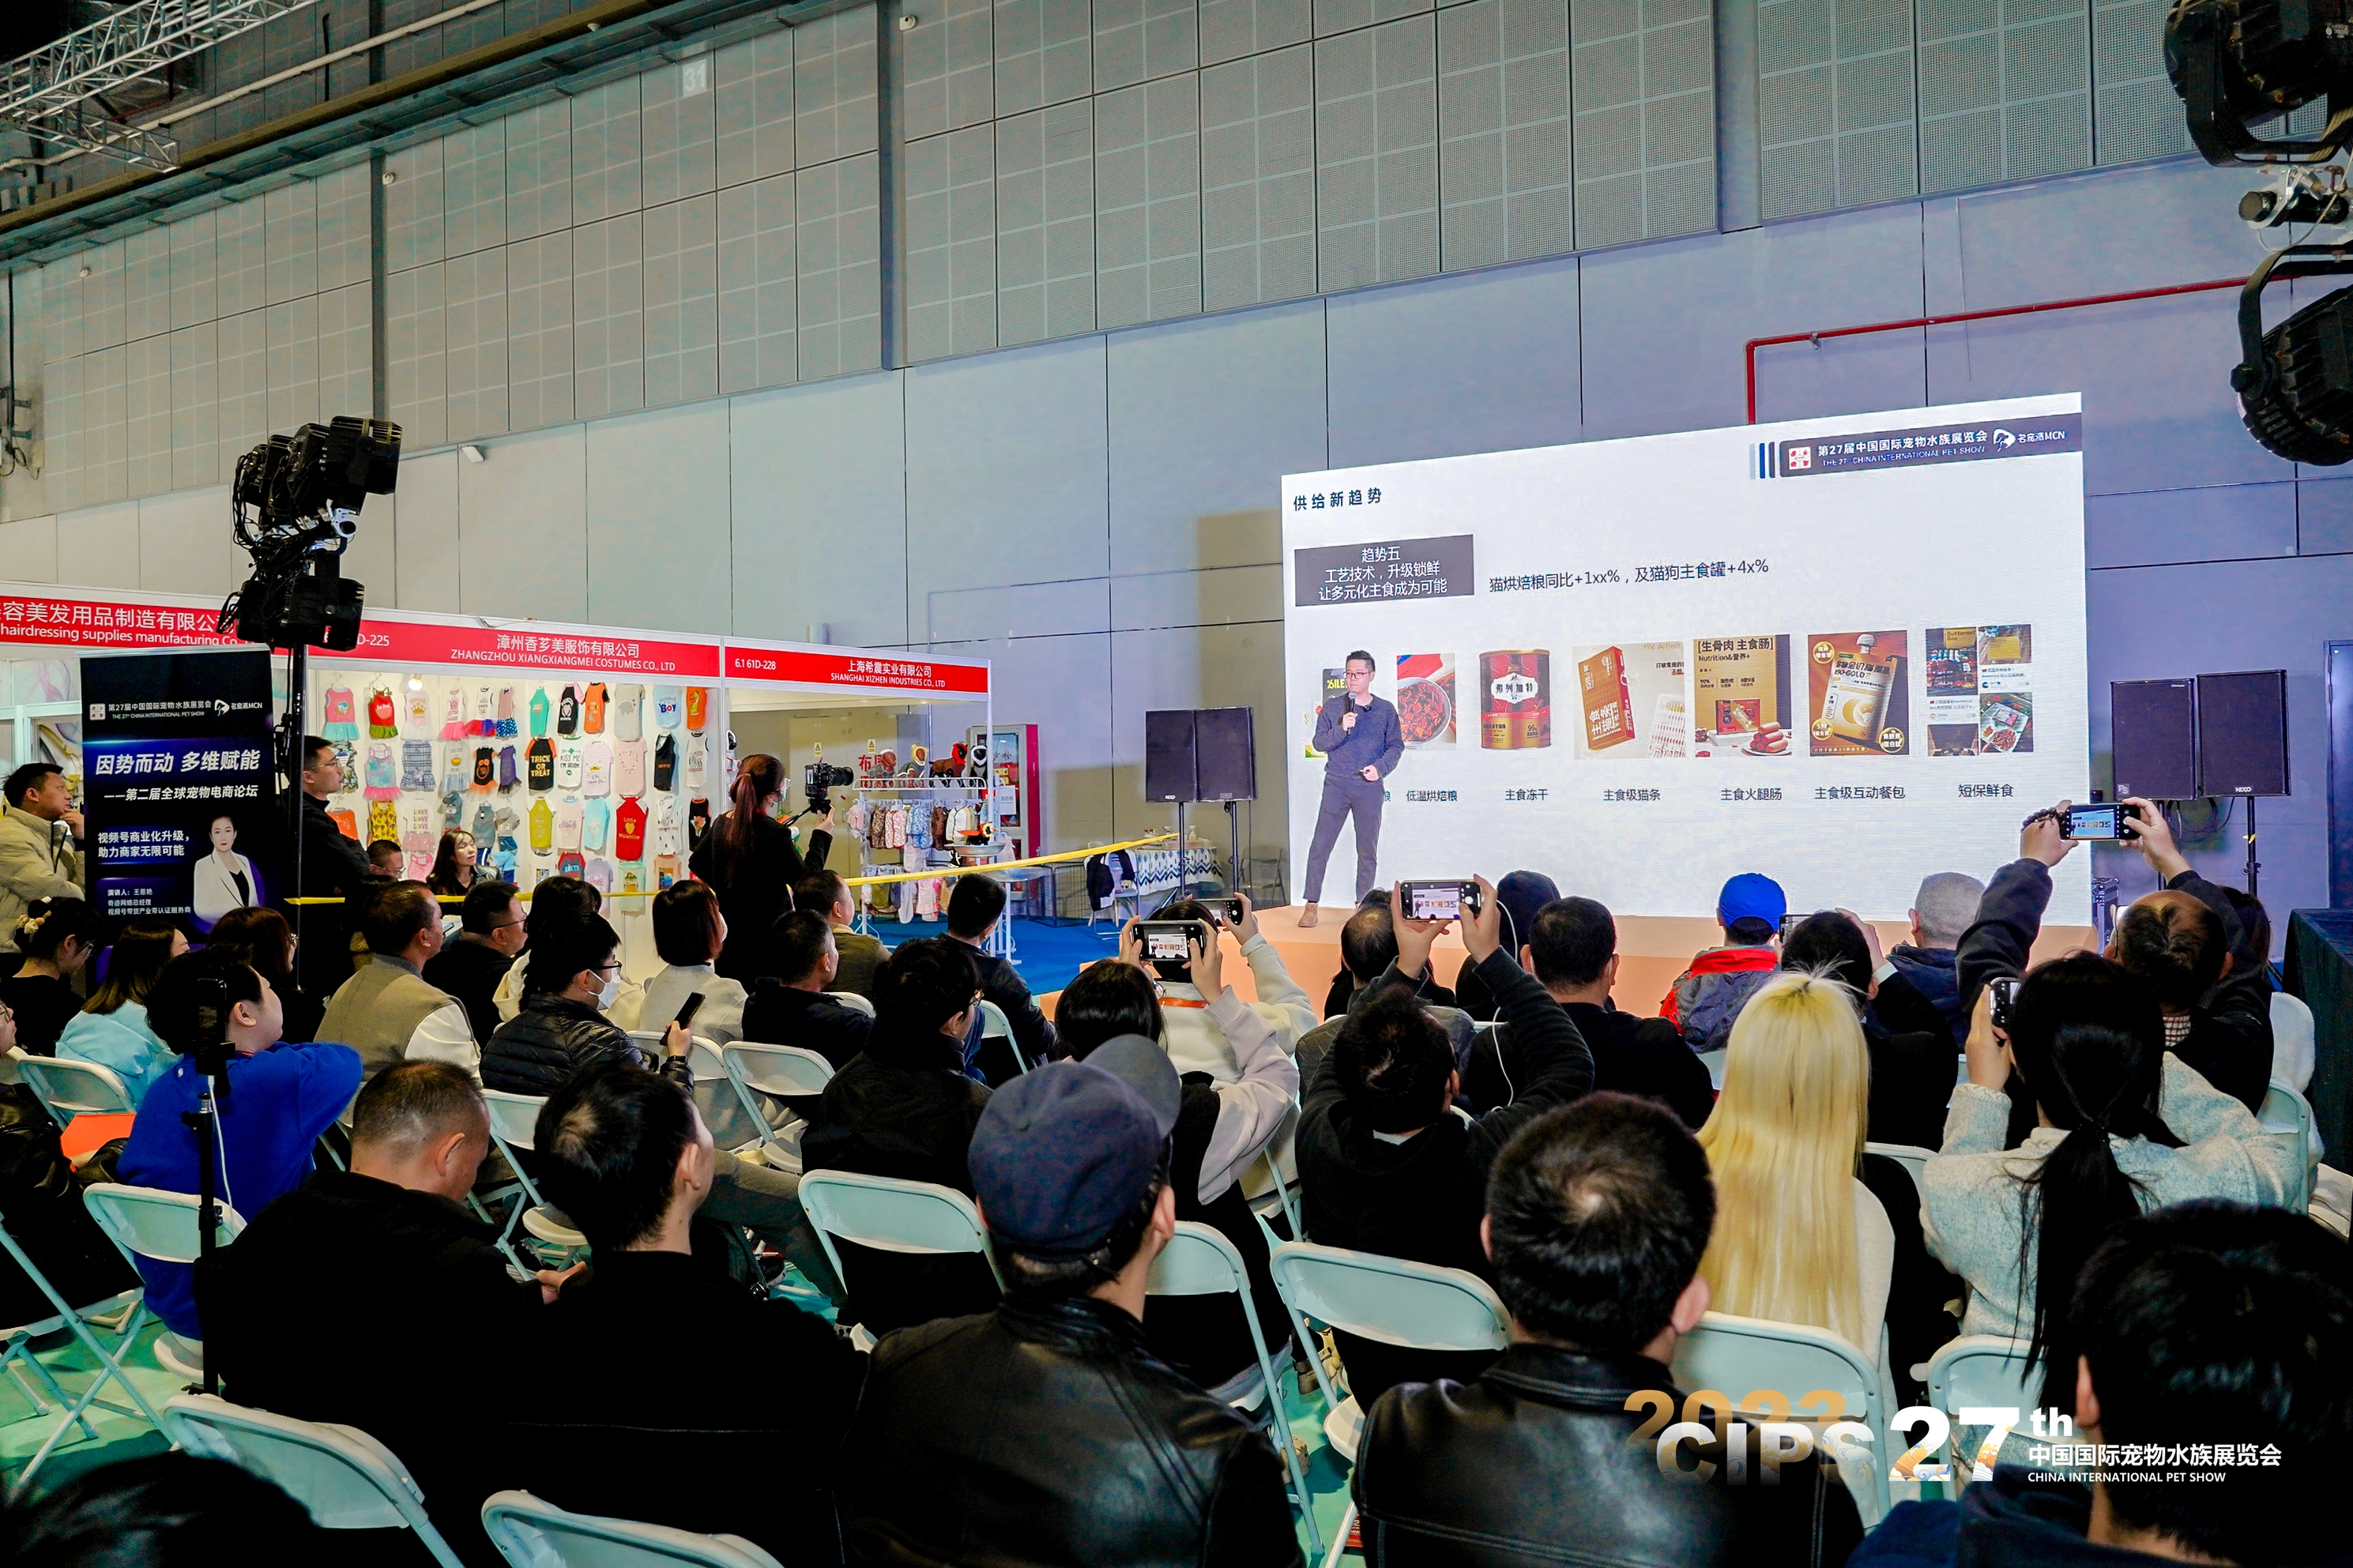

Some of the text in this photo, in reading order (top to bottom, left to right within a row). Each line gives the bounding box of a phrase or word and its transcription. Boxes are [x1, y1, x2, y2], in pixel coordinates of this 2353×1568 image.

[685, 63, 706, 92] 31
[1818, 430, 1987, 457] 第27届中国国际宠物水族展览会
[1878, 450, 1940, 461] INTERNATIONAL
[1942, 447, 1957, 456] PET
[1293, 487, 1382, 511] 供给新趋势
[1361, 546, 1401, 562] 趋势五
[1325, 560, 1440, 583] 工艺技术，升级锁鲜
[1319, 578, 1448, 601] 让多元化主食成为可能
[0, 600, 220, 633] 容美发用品制造有限公
[1, 622, 79, 641] hairdressing
[82, 629, 133, 643] supplies
[136, 632, 219, 645] manufacturing
[497, 634, 639, 658] 漳州香芗美服饰有限公司
[451, 649, 516, 662] ZHANGZHOU
[518, 653, 593, 667] XIANGXIANGMEI
[595, 657, 641, 669] COSTUMES
[661, 662, 676, 671] LTD
[735, 658, 776, 670] 6.1 61D-228
[847, 660, 932, 678] 上海希震实业有限公司
[830, 672, 864, 682] SHANGHAI
[889, 676, 922, 686] INDUSTRIES
[1496, 682, 1534, 694] 弗列加特
[108, 700, 212, 711] 第27届中国国际宠物水族展览会
[658, 704, 676, 713] BOY
[96, 749, 261, 775] 因势而动 多维赋能
[1406, 790, 1458, 802] 低温烘焙粮
[1504, 788, 1548, 800] 主食冻干
[1603, 788, 1661, 801] 主食级猫条
[1720, 788, 1782, 800] 主食火腿肠
[1814, 786, 1906, 799] 主食级互动餐包
[1958, 784, 2014, 798] 短保鲜食
[98, 830, 190, 844] 视频号商业化升级，
[98, 844, 185, 858] 助力商家无限可能
